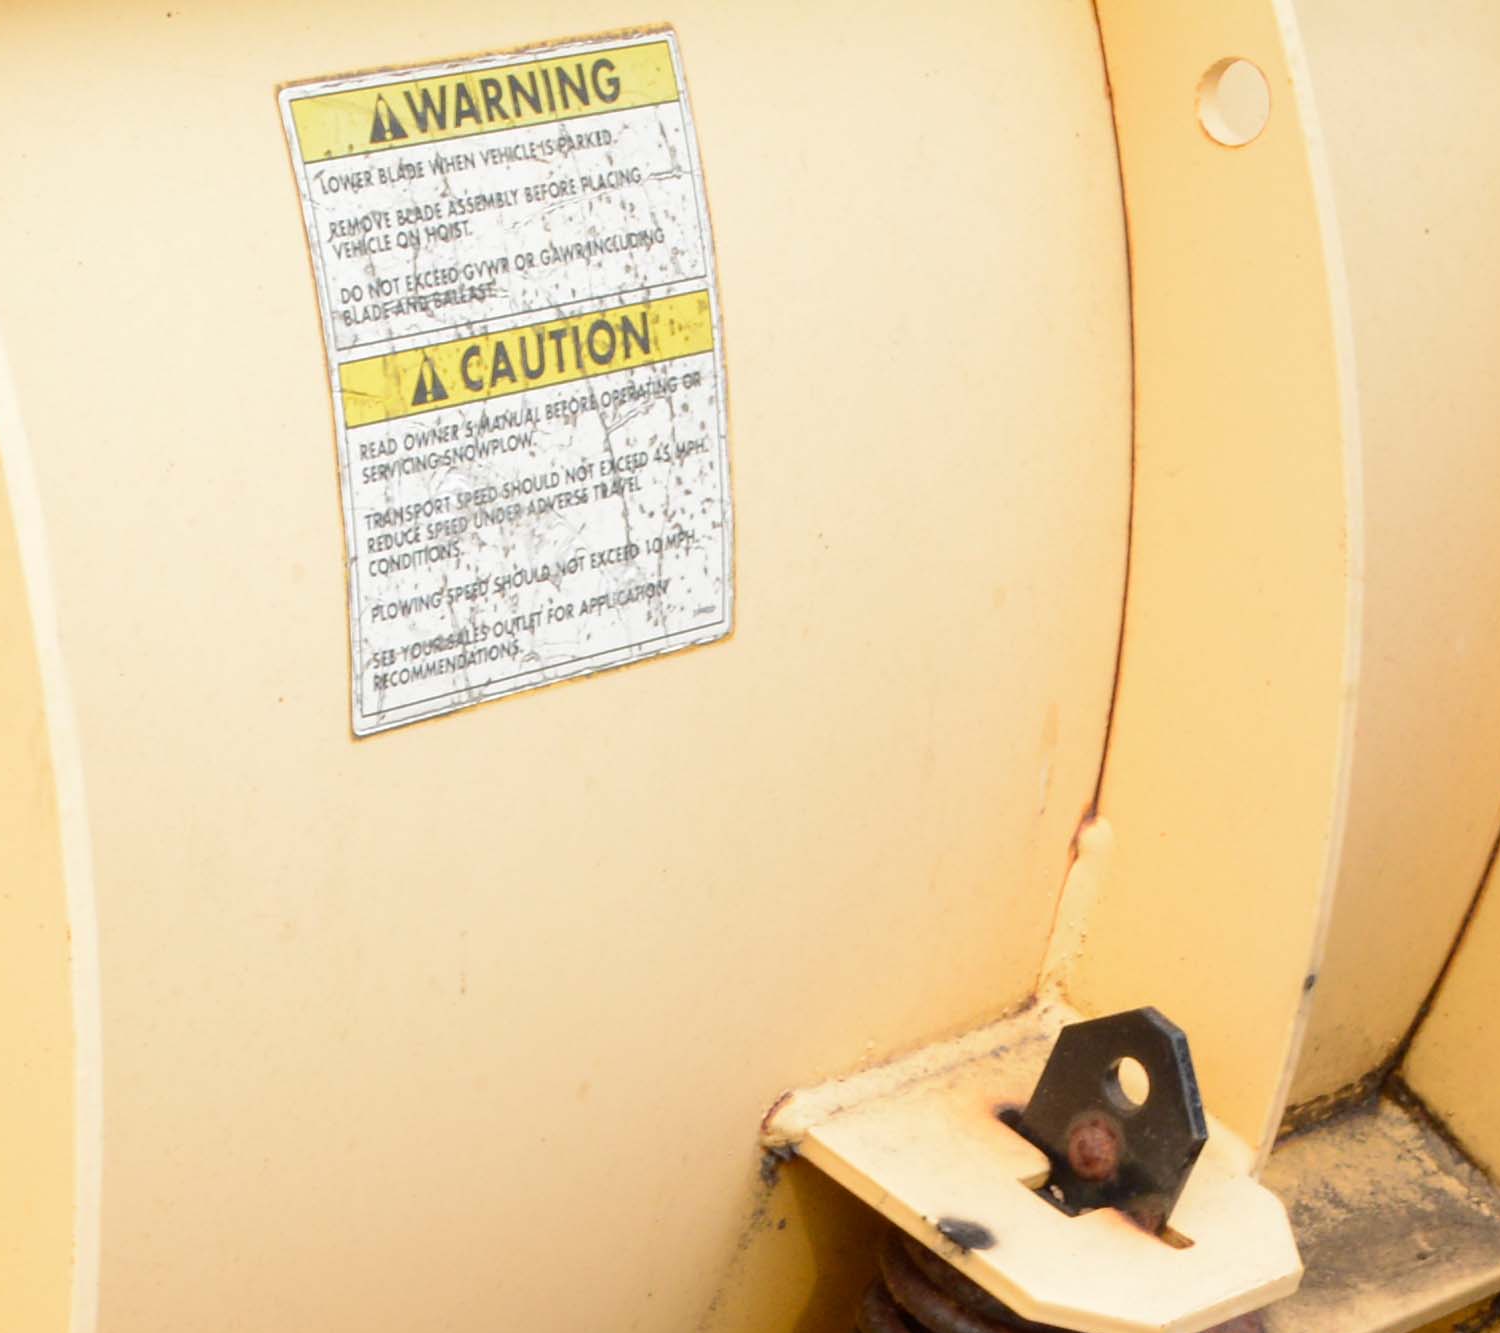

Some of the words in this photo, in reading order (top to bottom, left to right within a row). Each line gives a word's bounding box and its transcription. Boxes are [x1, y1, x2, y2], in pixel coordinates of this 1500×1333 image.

[403, 58, 620, 133] WARNING
[320, 170, 372, 194] LOWER
[379, 162, 424, 184] BLADE
[429, 153, 475, 175] WHEN
[480, 142, 537, 165] VEHICLE
[542, 140, 554, 154] IS
[557, 129, 617, 151] PARKED.
[329, 212, 392, 239] REMOVE
[397, 203, 442, 225] BLADE
[447, 190, 519, 216] ASSEMBLY
[525, 179, 575, 203] BEFORE
[581, 167, 641, 193] PLACING
[332, 235, 392, 259] VEHICLE
[396, 229, 420, 248] ON
[425, 220, 473, 243] HOIST.
[341, 285, 363, 304] DO
[368, 277, 400, 298] NOT
[407, 267, 459, 293] EXCEED
[462, 256, 509, 281] GVWR
[514, 252, 535, 270] OR
[588, 228, 665, 255] INCLUDING
[342, 304, 390, 326] BLADE
[394, 296, 429, 315] AND
[461, 312, 650, 391] CAUTION
[360, 438, 397, 460] READ
[477, 411, 540, 436] MANUAL
[546, 395, 598, 419] BEFORE
[601, 377, 677, 407] OPERATING
[682, 371, 701, 390] OR
[362, 453, 440, 484] SERVICING
[444, 432, 537, 465] SNOWPLOW.
[364, 496, 450, 530] TRANSPORT
[456, 487, 497, 510] SPEED
[502, 472, 559, 498] SHOULD
[565, 463, 594, 483] NOT
[600, 452, 648, 474] EXCEED
[653, 443, 670, 462] 45
[368, 527, 421, 552] REDUCE
[427, 517, 468, 540] SPEED
[474, 503, 521, 528] UNDER
[527, 488, 588, 515] ADVERSE
[594, 476, 642, 499] TRAVEL
[369, 541, 464, 577] CONDITIONS.
[371, 592, 441, 622] PLOWING
[448, 580, 489, 601] SPEED
[493, 565, 550, 594] SHOULD
[556, 556, 585, 576] NOT
[591, 544, 640, 568] EXCEED
[646, 537, 663, 554] 10
[373, 650, 396, 669] SEE
[401, 635, 444, 661] YOUR
[448, 625, 489, 649] SALES
[493, 610, 542, 637] OUTLET
[548, 605, 573, 624] FOR
[579, 579, 670, 617] APPLICATION
[374, 640, 524, 691] RECOMMENDATIONS.
